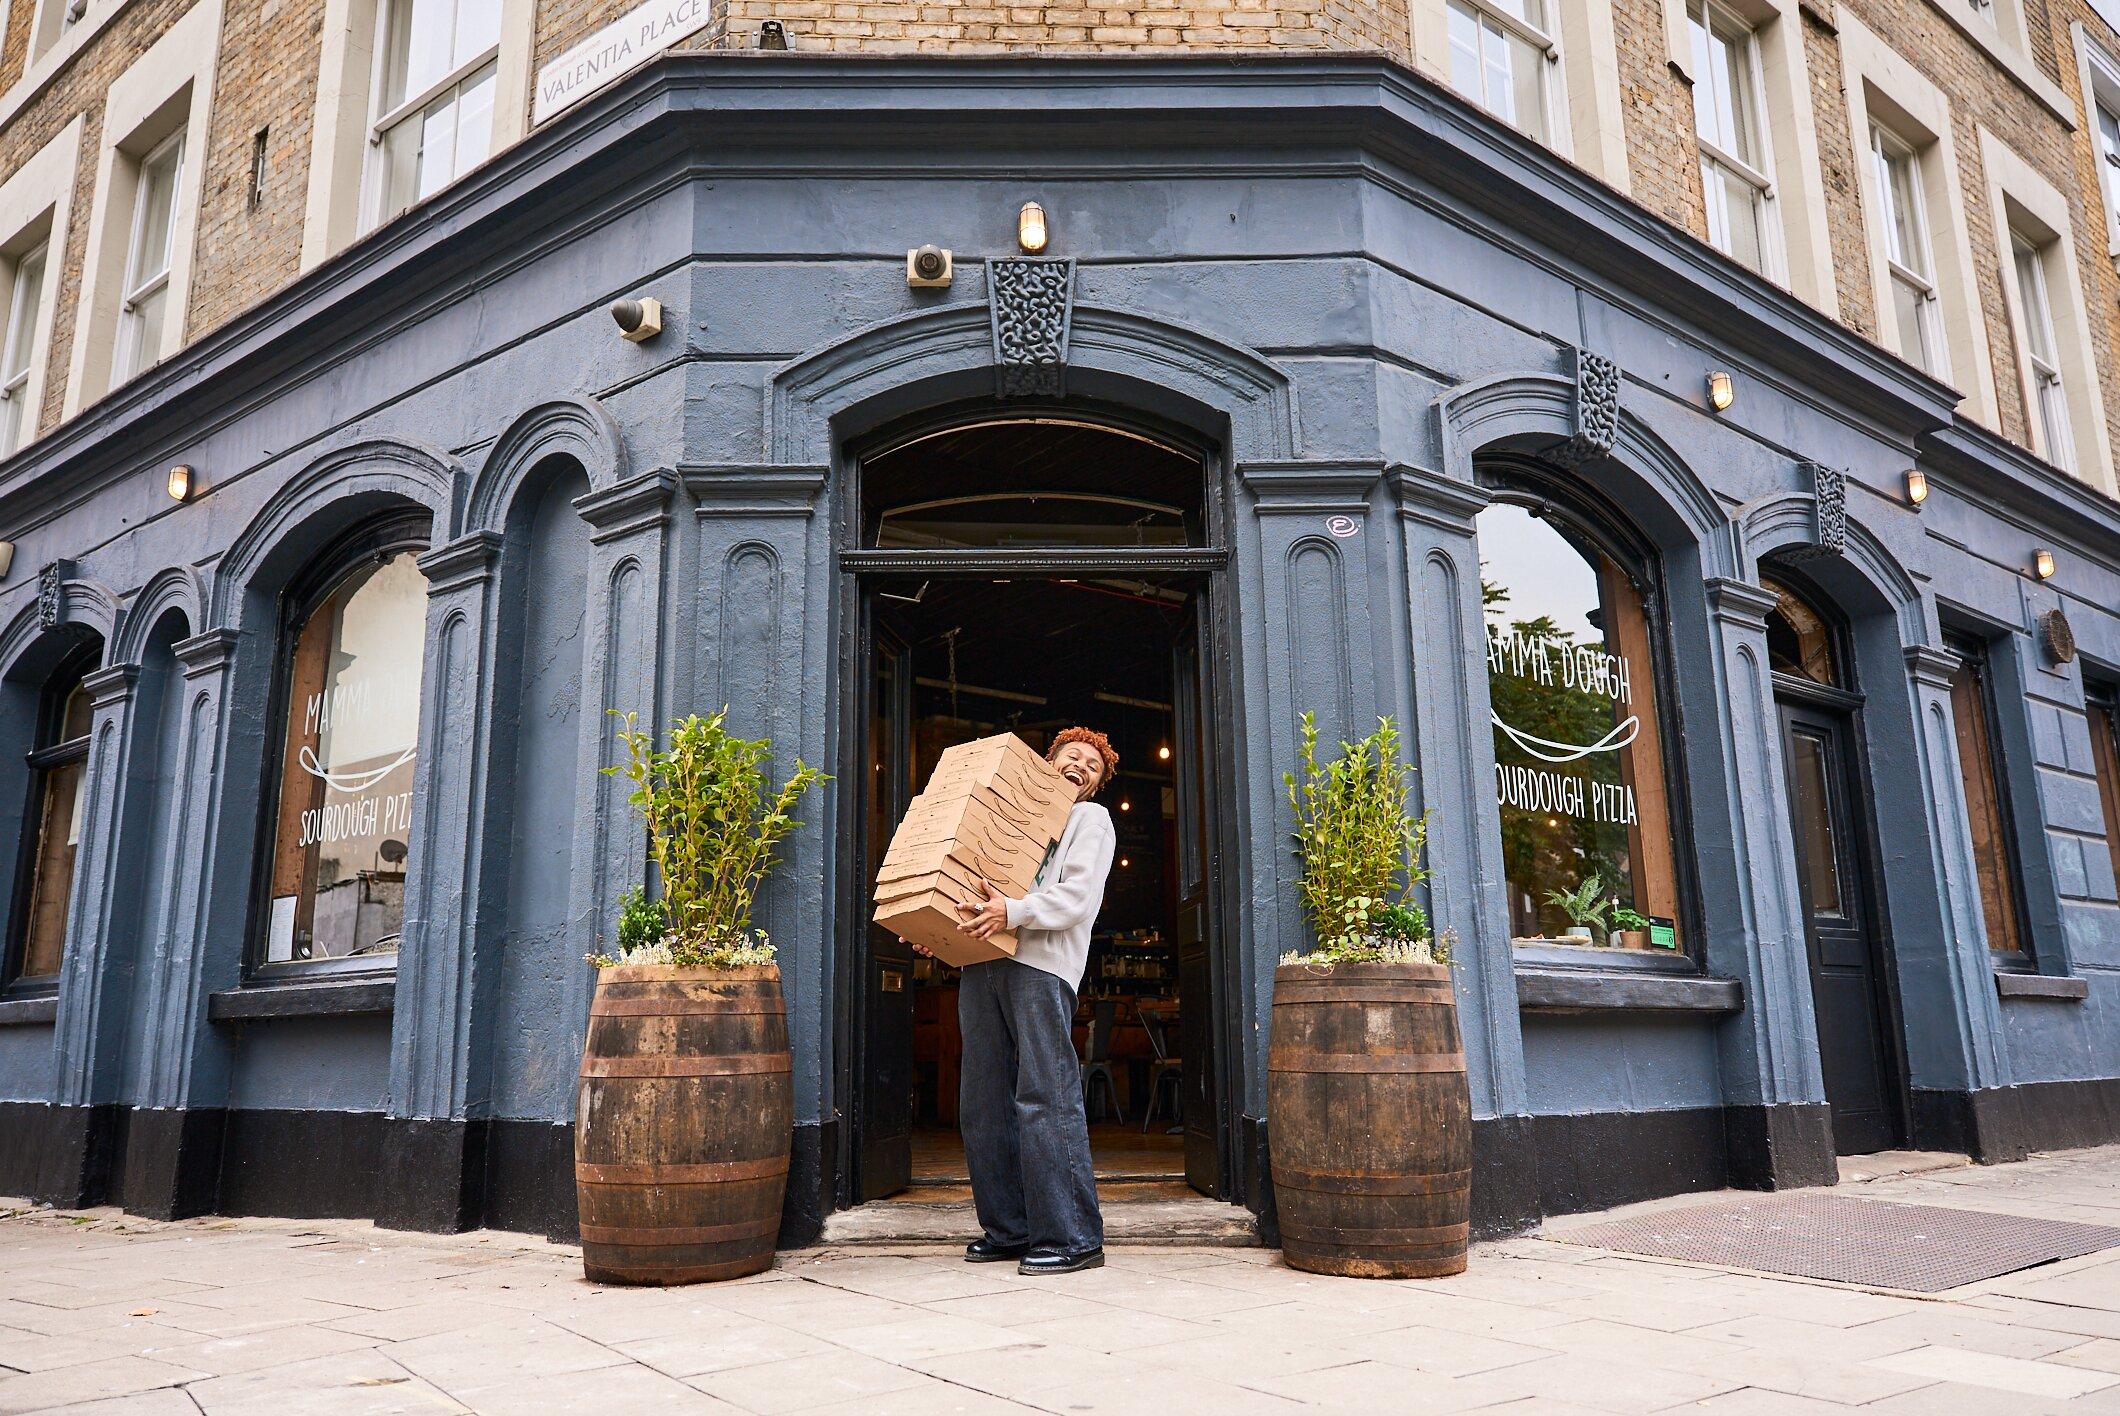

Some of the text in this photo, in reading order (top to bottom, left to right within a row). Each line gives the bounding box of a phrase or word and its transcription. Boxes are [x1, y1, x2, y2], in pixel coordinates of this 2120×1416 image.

[543, 38, 632, 103] VALENTIA
[640, 0, 701, 46] PLACE
[1484, 617, 1632, 705] AMMA DOUGH
[304, 677, 370, 735] MAMMA
[299, 791, 414, 847] SOURDOUGH PIZ
[1495, 762, 1638, 826] OURDOUGH PIZZA
